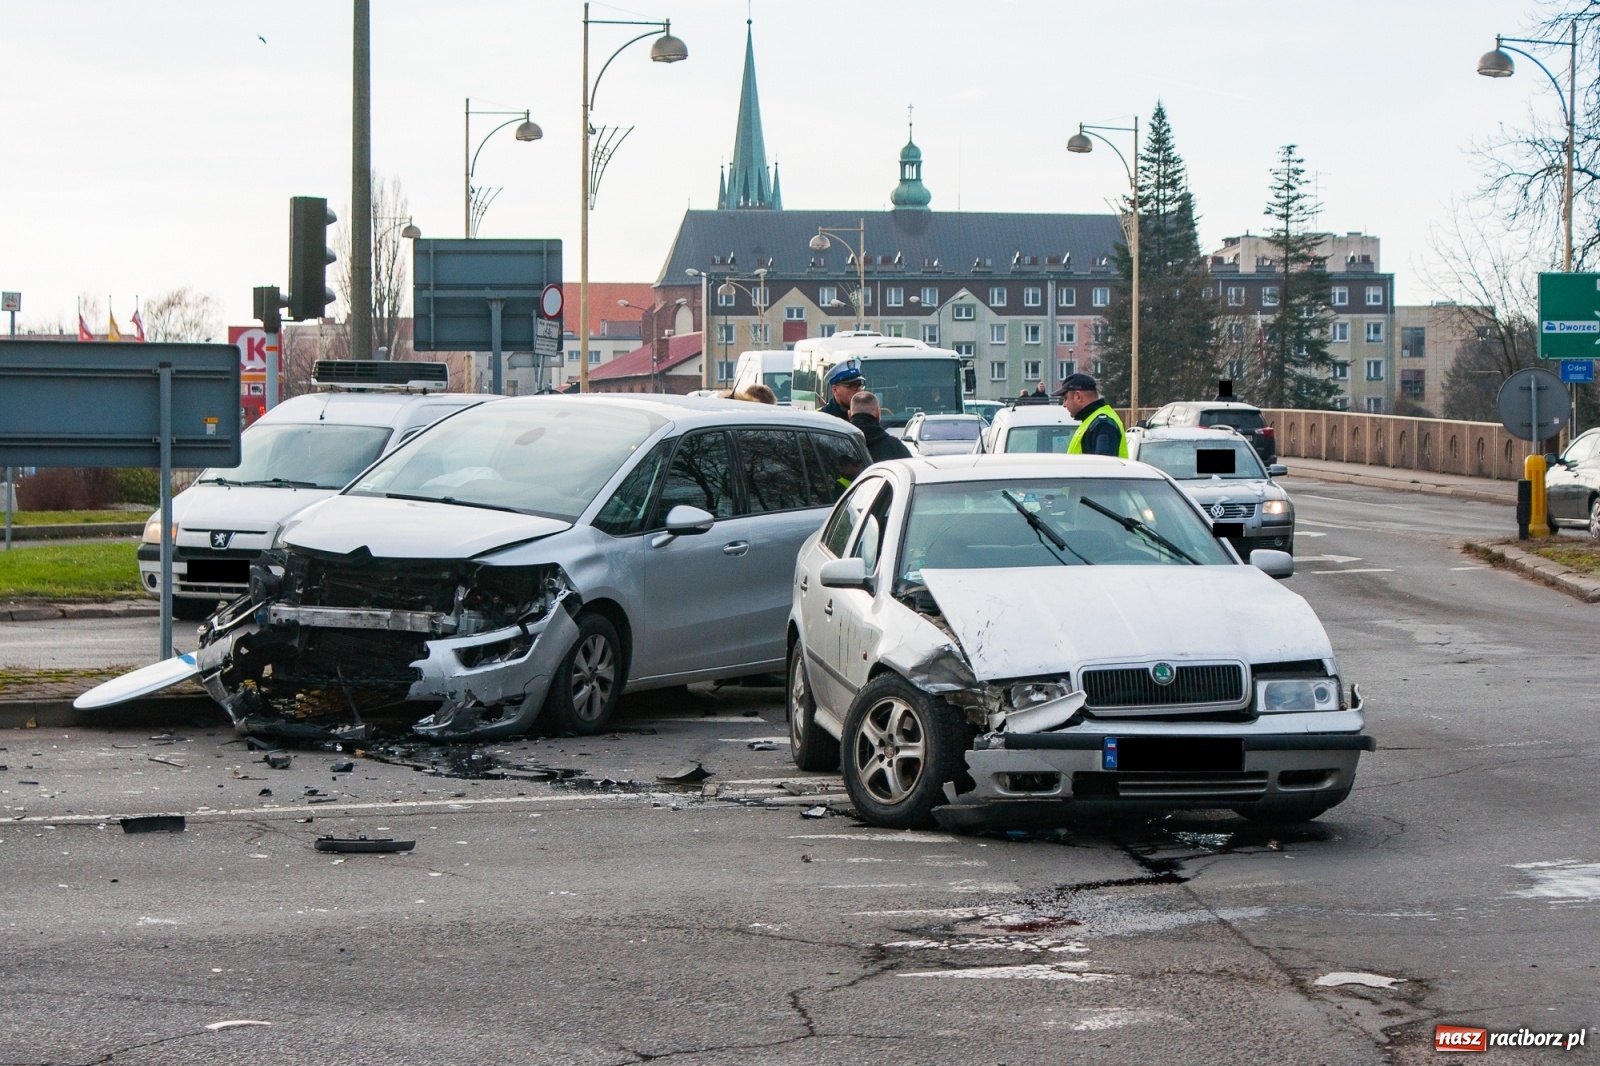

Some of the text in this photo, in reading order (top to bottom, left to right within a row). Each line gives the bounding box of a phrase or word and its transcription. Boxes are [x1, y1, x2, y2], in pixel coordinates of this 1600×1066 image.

[1559, 322, 1597, 331] Dworzec
[247, 337, 266, 364] K
[1106, 755, 1115, 763] PL
